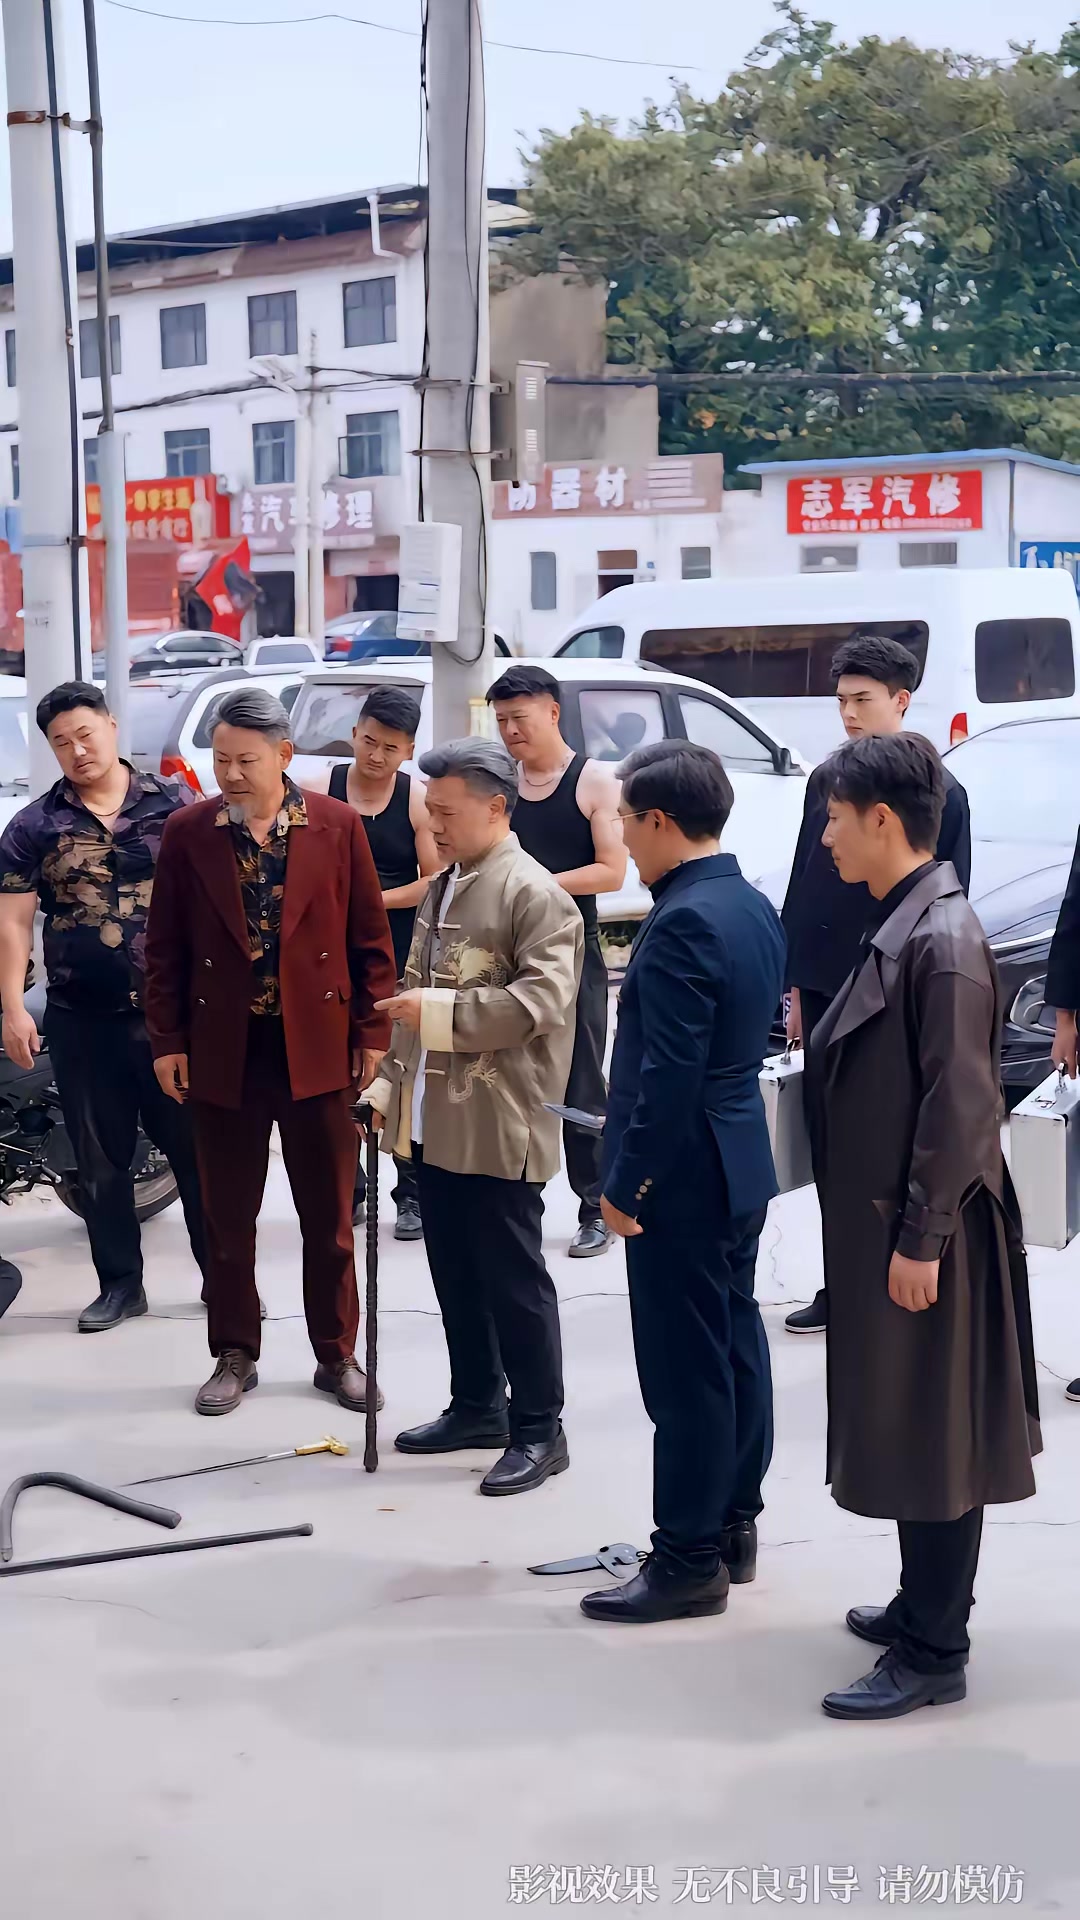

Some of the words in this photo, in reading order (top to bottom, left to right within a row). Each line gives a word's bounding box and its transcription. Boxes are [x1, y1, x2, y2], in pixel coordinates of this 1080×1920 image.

[260, 490, 373, 533] 汽修理
[801, 473, 961, 519] 志军汽修
